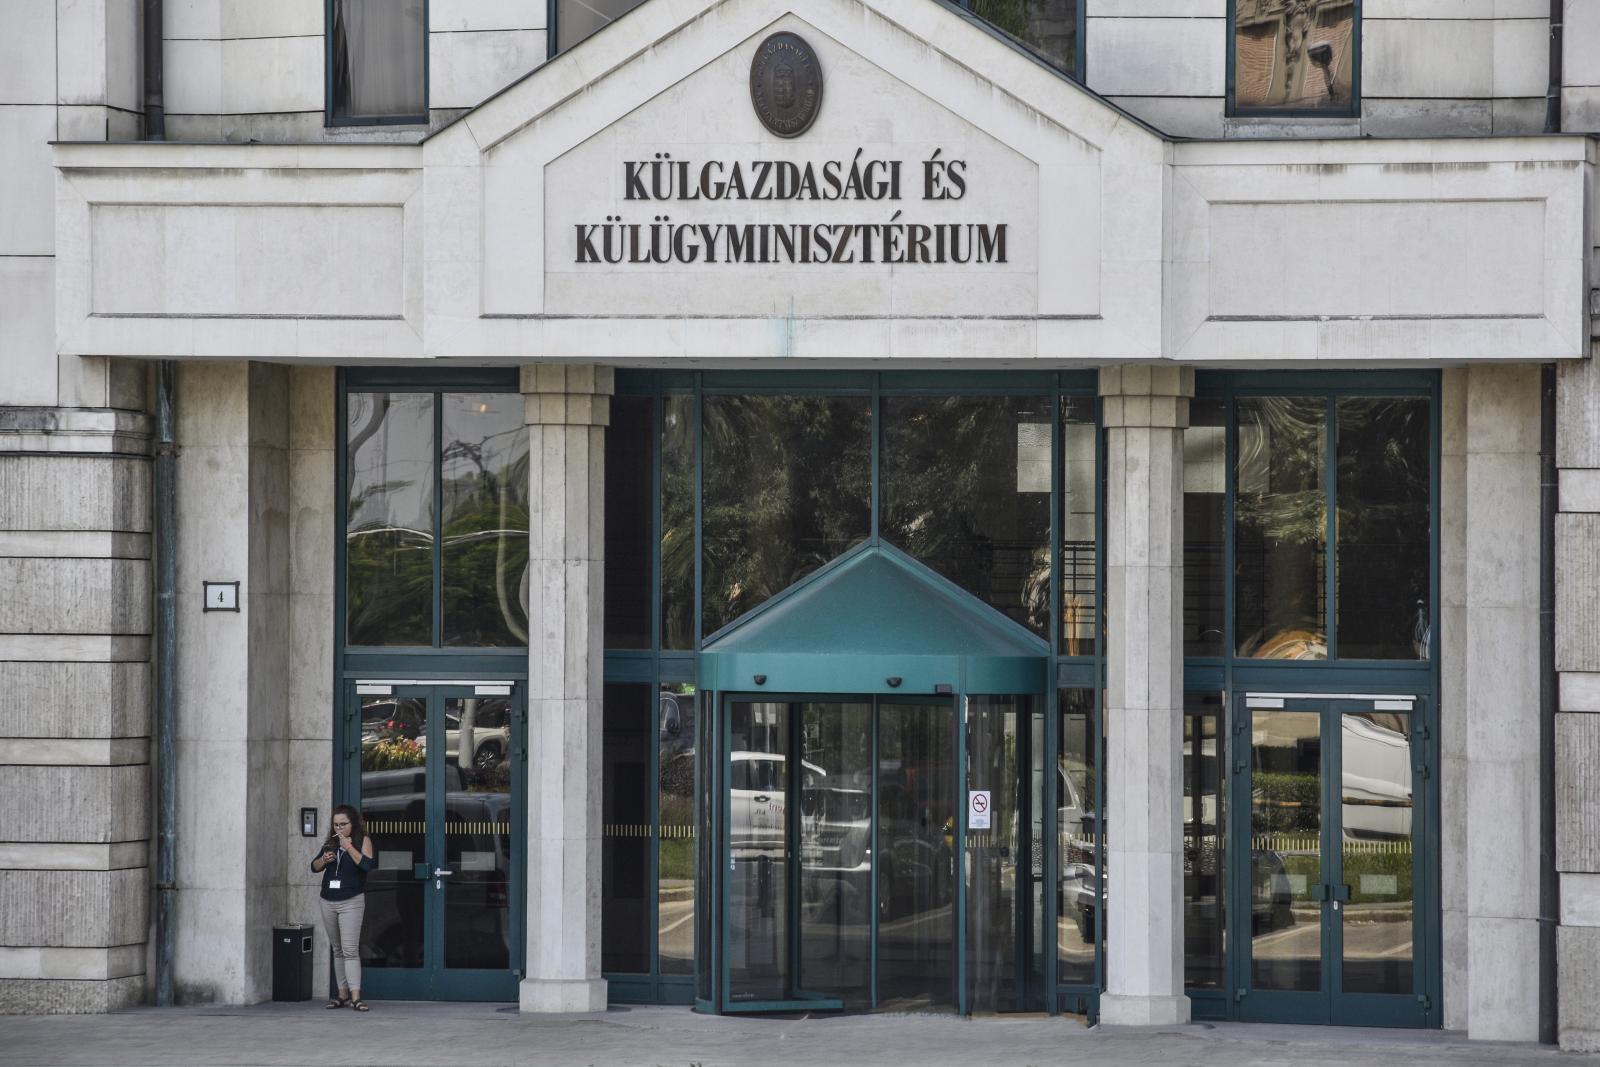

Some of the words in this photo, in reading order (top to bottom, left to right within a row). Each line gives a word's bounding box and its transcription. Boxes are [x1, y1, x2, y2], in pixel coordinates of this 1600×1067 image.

[623, 147, 903, 201] KÜLGAZDASÁGI
[921, 147, 967, 201] ÉS
[574, 209, 1008, 264] KÜLÜGYMINISZTÉRIUM
[217, 591, 224, 603] 4
